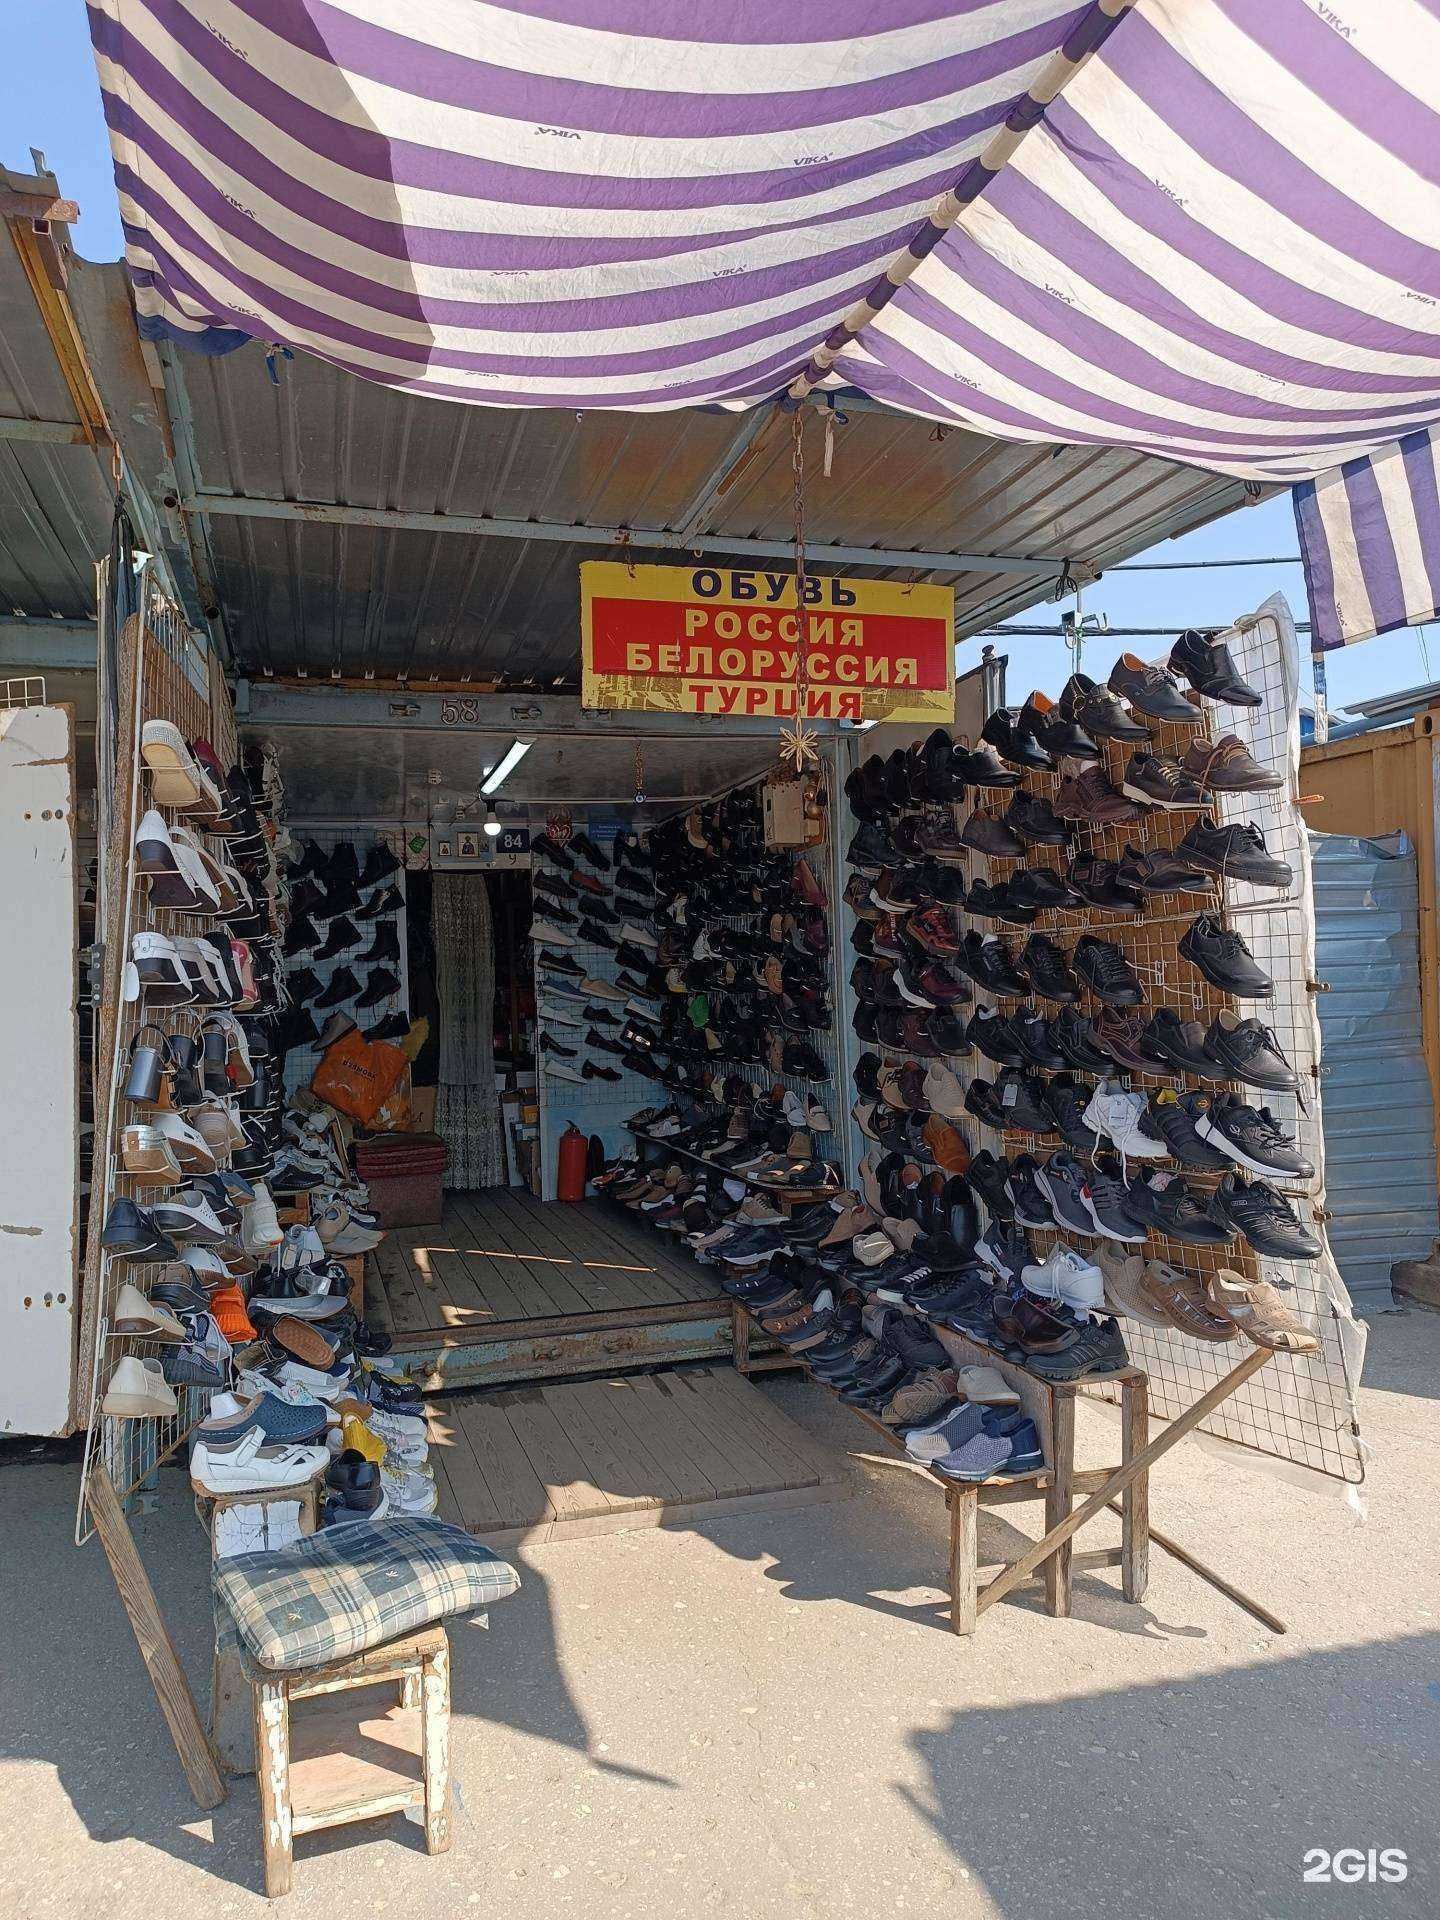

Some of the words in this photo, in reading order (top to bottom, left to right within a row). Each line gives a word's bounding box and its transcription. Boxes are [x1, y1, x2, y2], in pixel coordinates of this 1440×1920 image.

[1318, 1, 1350, 38] VIKA
[205, 20, 248, 60] VIKA
[537, 127, 581, 140] VIKA
[793, 154, 829, 166] VIKA
[1154, 178, 1185, 206] VIKA
[712, 266, 744, 277] VIKA
[1044, 283, 1072, 304] VIKA
[1406, 292, 1437, 306] VIKA
[953, 372, 978, 388] VIKA
[691, 568, 857, 607] ОБУВЬ
[684, 608, 864, 648] РОССИЯ
[625, 642, 918, 685] БЕЛОРУССИЯ
[441, 698, 479, 726] 58
[689, 684, 862, 720] ТУРЦИЯ
